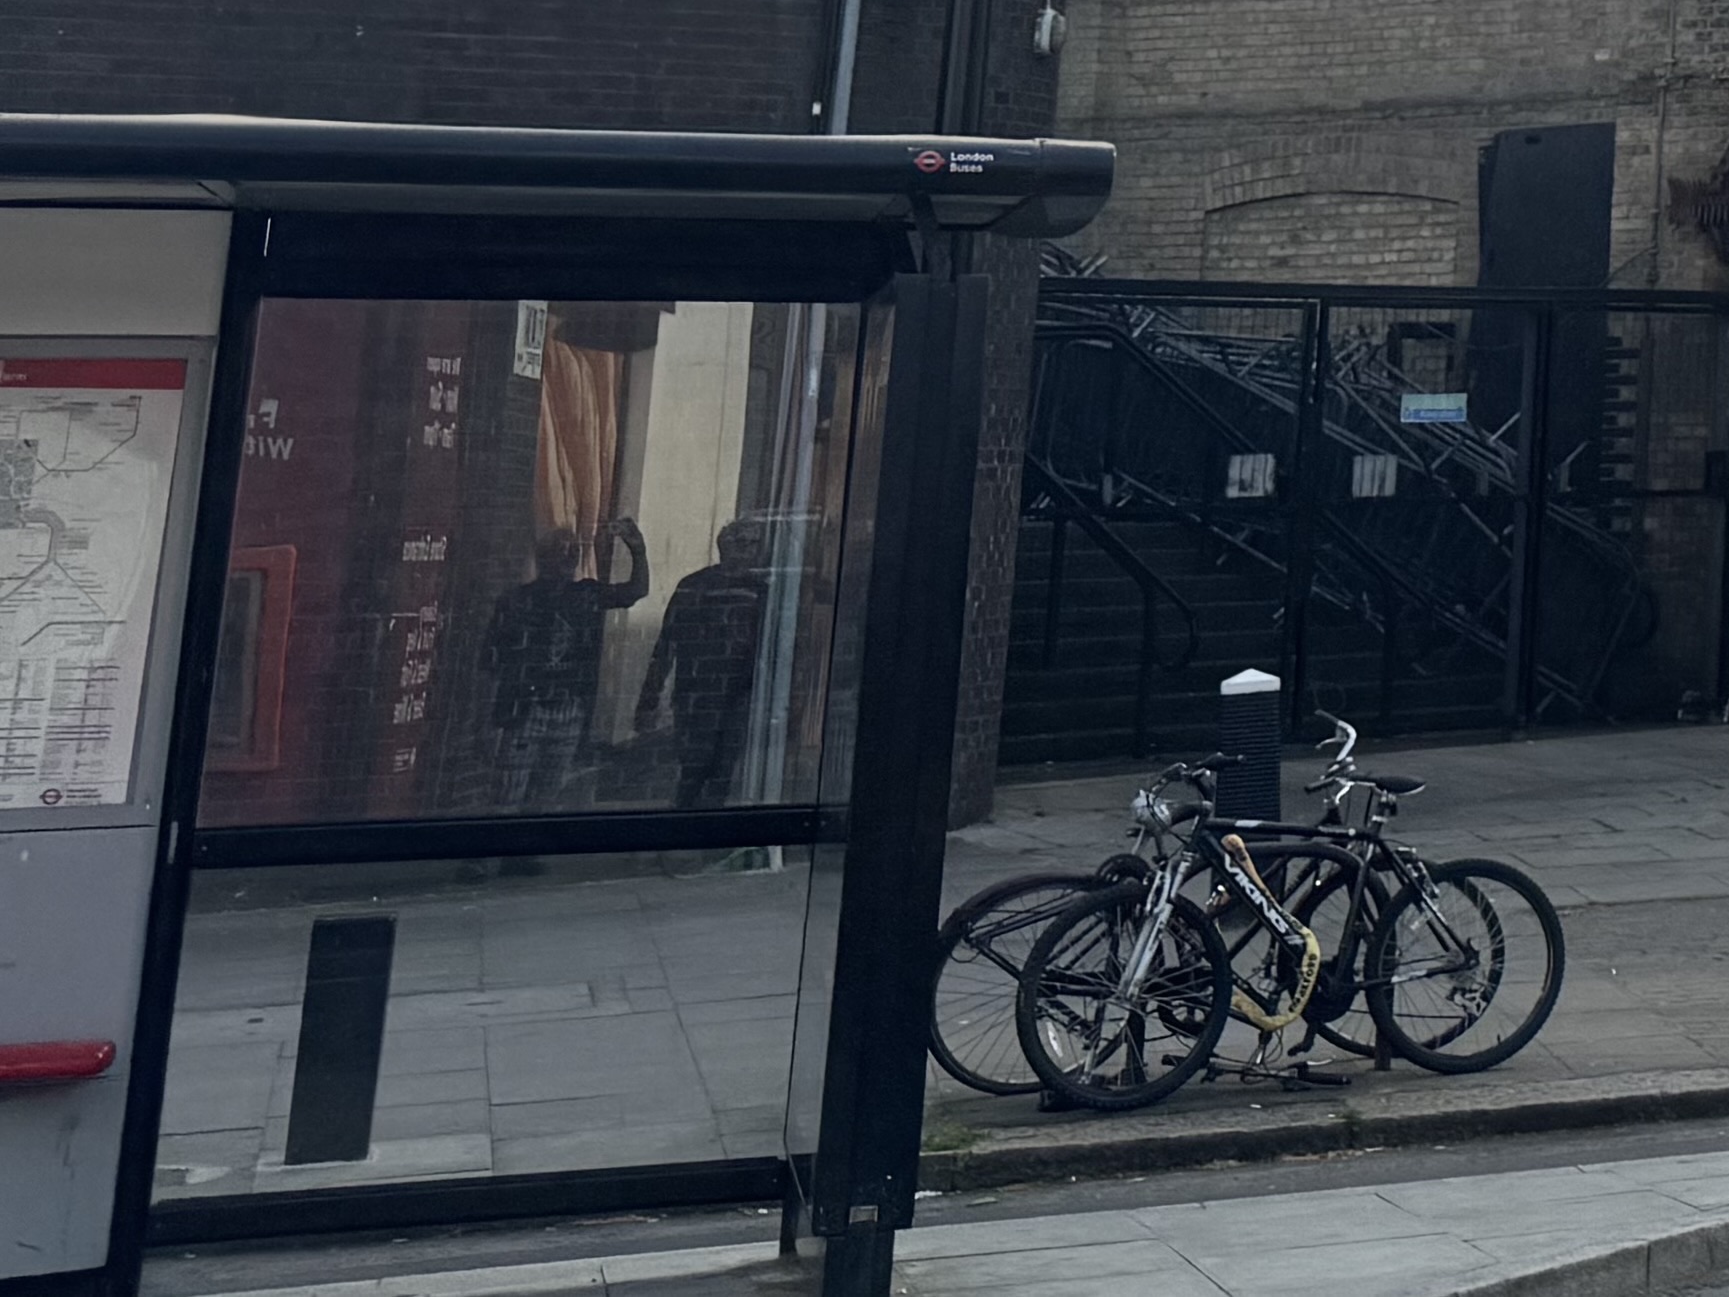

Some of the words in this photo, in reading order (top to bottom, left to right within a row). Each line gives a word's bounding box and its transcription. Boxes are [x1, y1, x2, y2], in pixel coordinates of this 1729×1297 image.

[950, 152, 994, 162] London
[950, 162, 983, 173] Buses
[1224, 853, 1289, 933] VIKING
